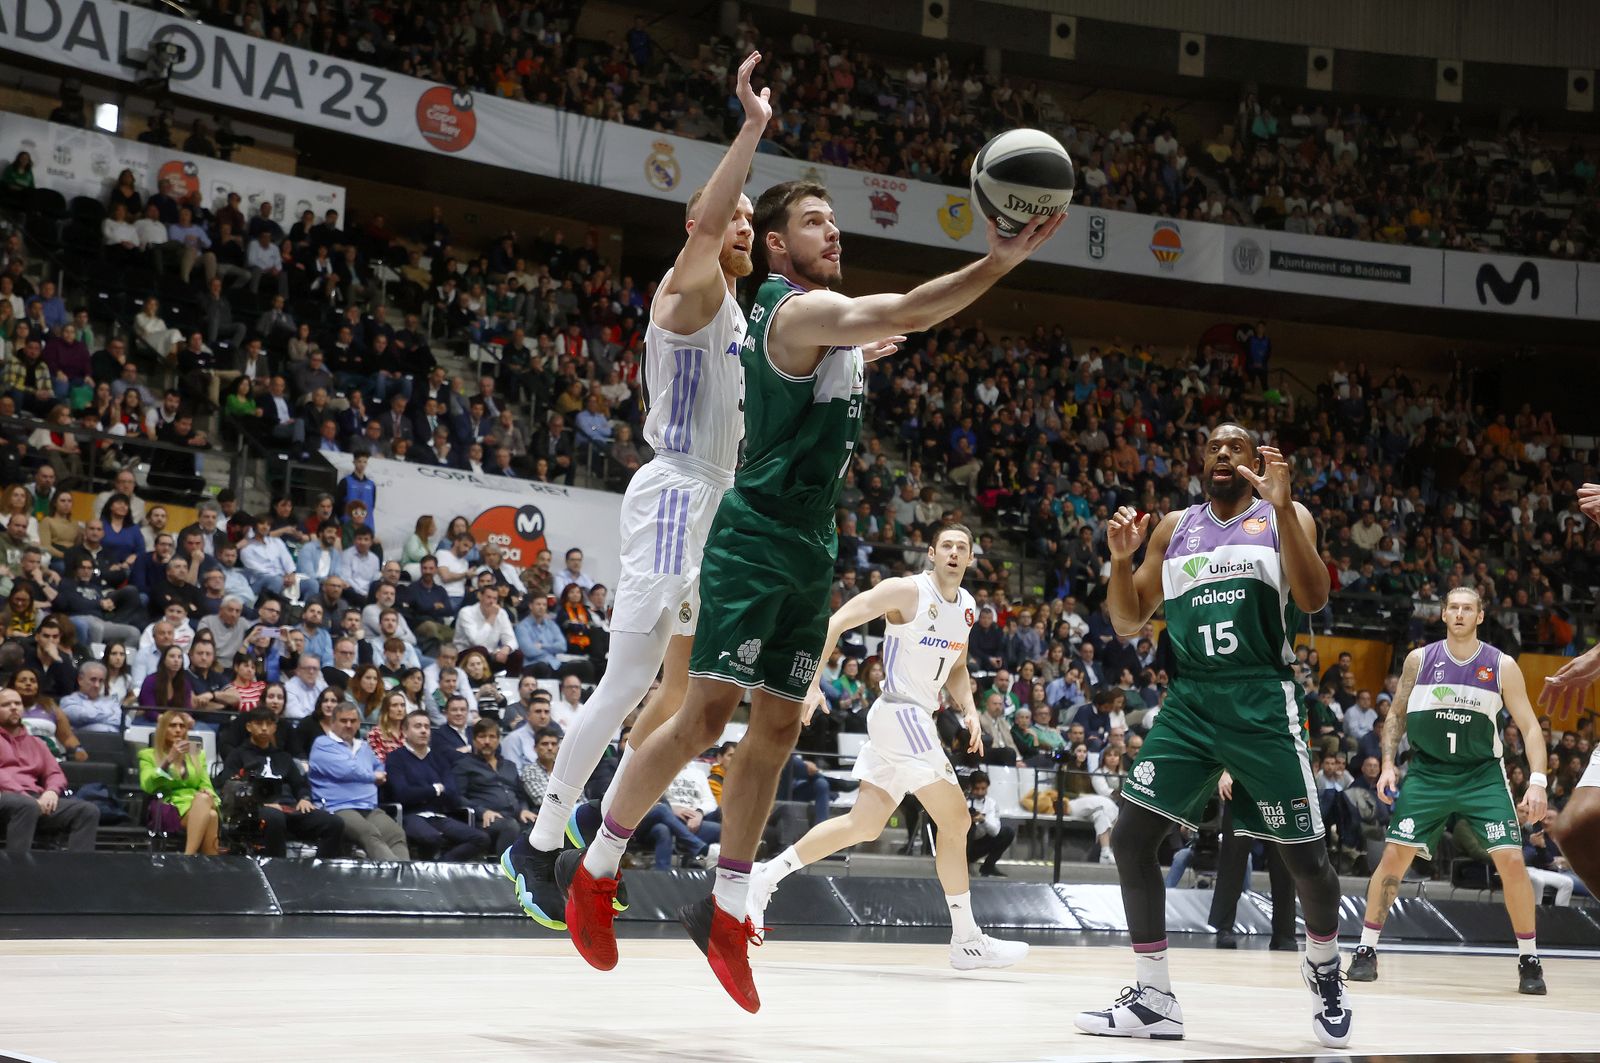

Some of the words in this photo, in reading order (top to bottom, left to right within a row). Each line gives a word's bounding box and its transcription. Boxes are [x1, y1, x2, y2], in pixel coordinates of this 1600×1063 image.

[0, 0, 388, 127] DALONA'23
[863, 176, 908, 192] CAZOO
[1278, 256, 1336, 273] Ajuntament
[1340, 264, 1353, 273] de
[1355, 265, 1402, 279] Badalona
[417, 466, 484, 485] COPA
[530, 483, 570, 497] REY
[488, 533, 512, 546] acb
[1209, 559, 1255, 575] Unicaja
[1198, 620, 1239, 657] 15
[933, 656, 946, 681] 1
[1454, 696, 1481, 707] Unicaja
[1446, 732, 1457, 754] 1
